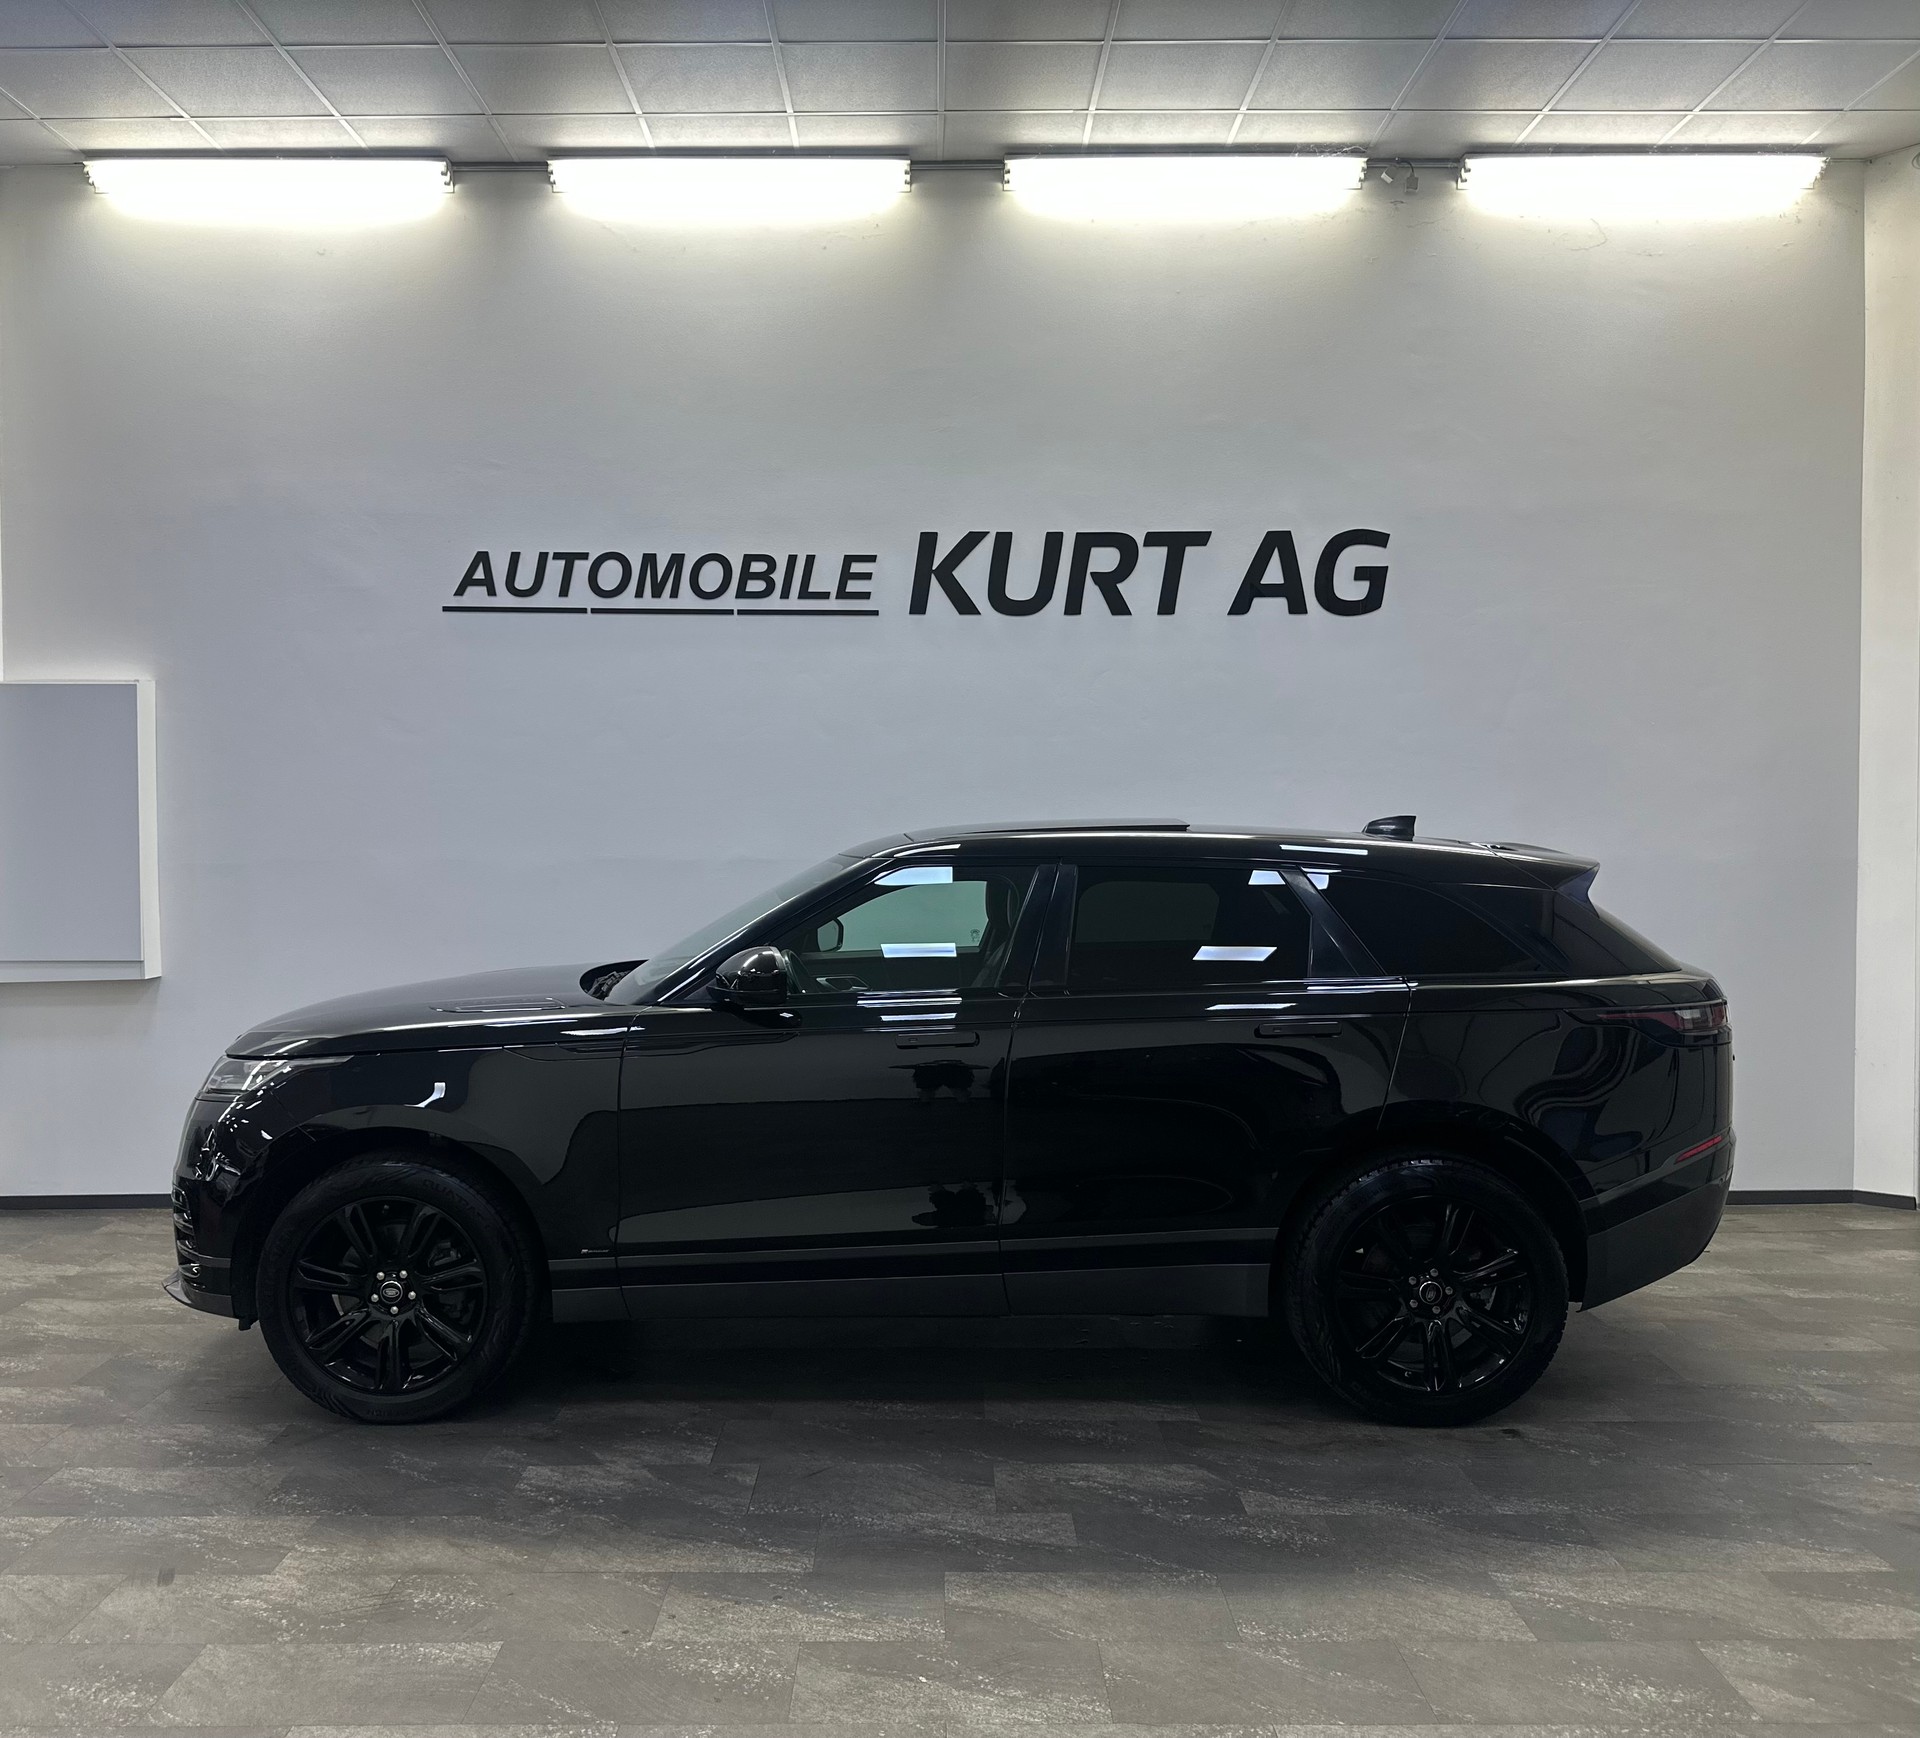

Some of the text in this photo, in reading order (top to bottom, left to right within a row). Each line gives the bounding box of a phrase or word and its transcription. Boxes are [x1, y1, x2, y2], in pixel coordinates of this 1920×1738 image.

[452, 528, 1392, 617] AUTOMOBILE KURT AG
